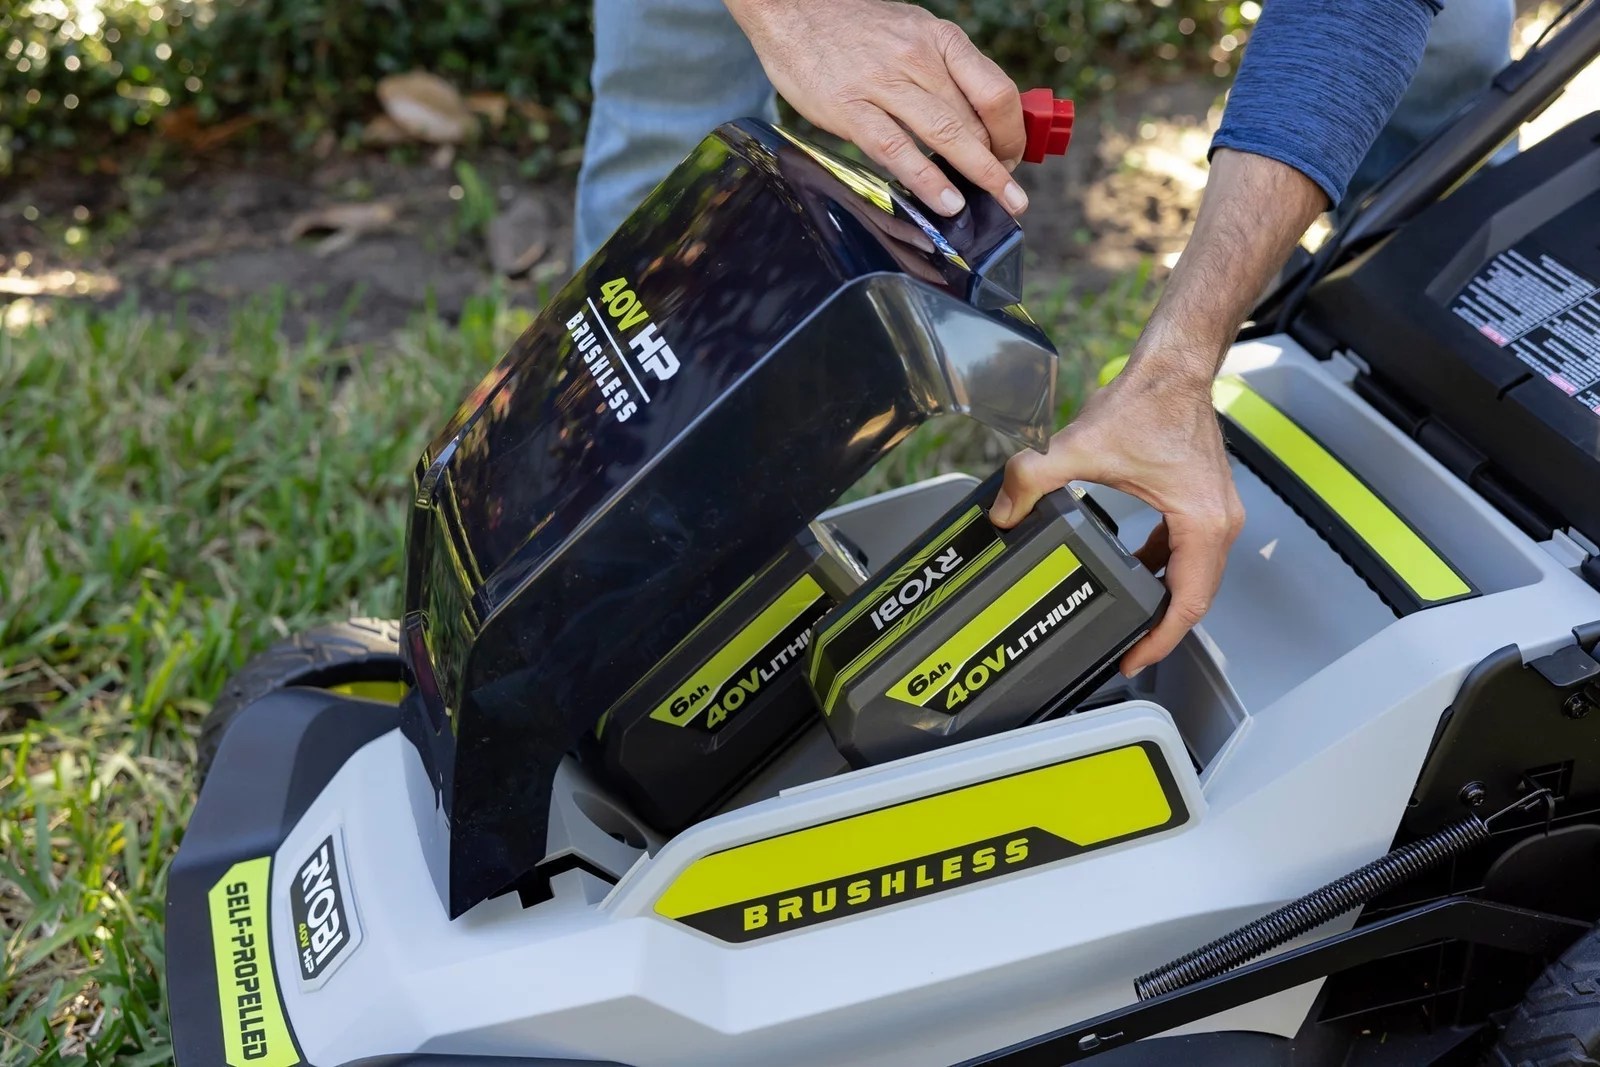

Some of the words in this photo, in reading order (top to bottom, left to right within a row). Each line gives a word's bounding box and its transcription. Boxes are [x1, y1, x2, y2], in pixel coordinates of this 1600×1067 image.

[565, 311, 638, 423] BRUSHLESS
[600, 277, 649, 331] 40V
[628, 322, 681, 381] HP
[870, 546, 964, 631] RYOBI
[669, 684, 710, 718] 6Ah
[907, 661, 952, 697] 6Ah
[301, 844, 343, 966] RYOBI
[744, 837, 1029, 931] BRUSHLESS
[226, 881, 268, 1061] SELF-PROPELLED
[298, 922, 310, 948] 40V
[302, 947, 314, 974] HP
